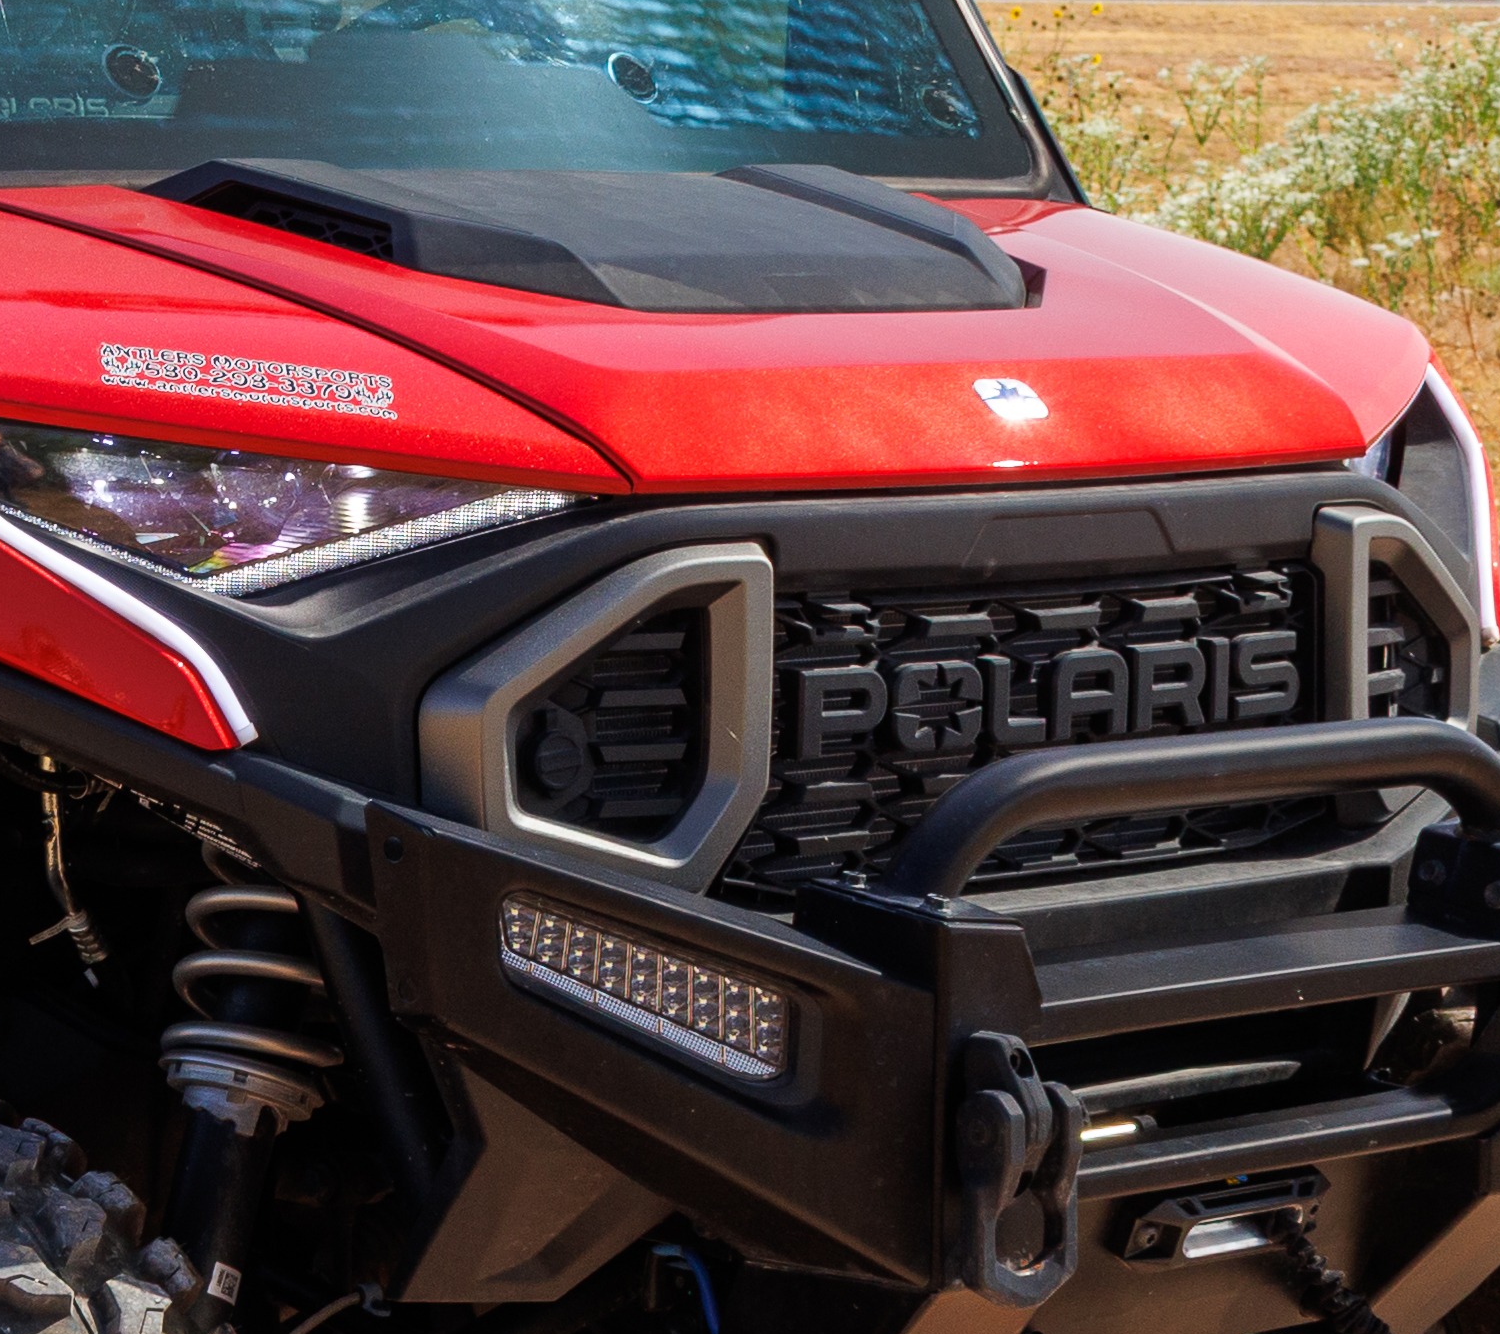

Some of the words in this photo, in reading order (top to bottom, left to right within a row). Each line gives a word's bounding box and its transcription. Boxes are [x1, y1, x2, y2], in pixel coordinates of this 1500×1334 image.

[101, 344, 205, 366] ANTLERS
[211, 355, 393, 389] MOTORSPORTS
[144, 362, 353, 400] 580-298-3379
[800, 630, 1301, 759] POLARIS
